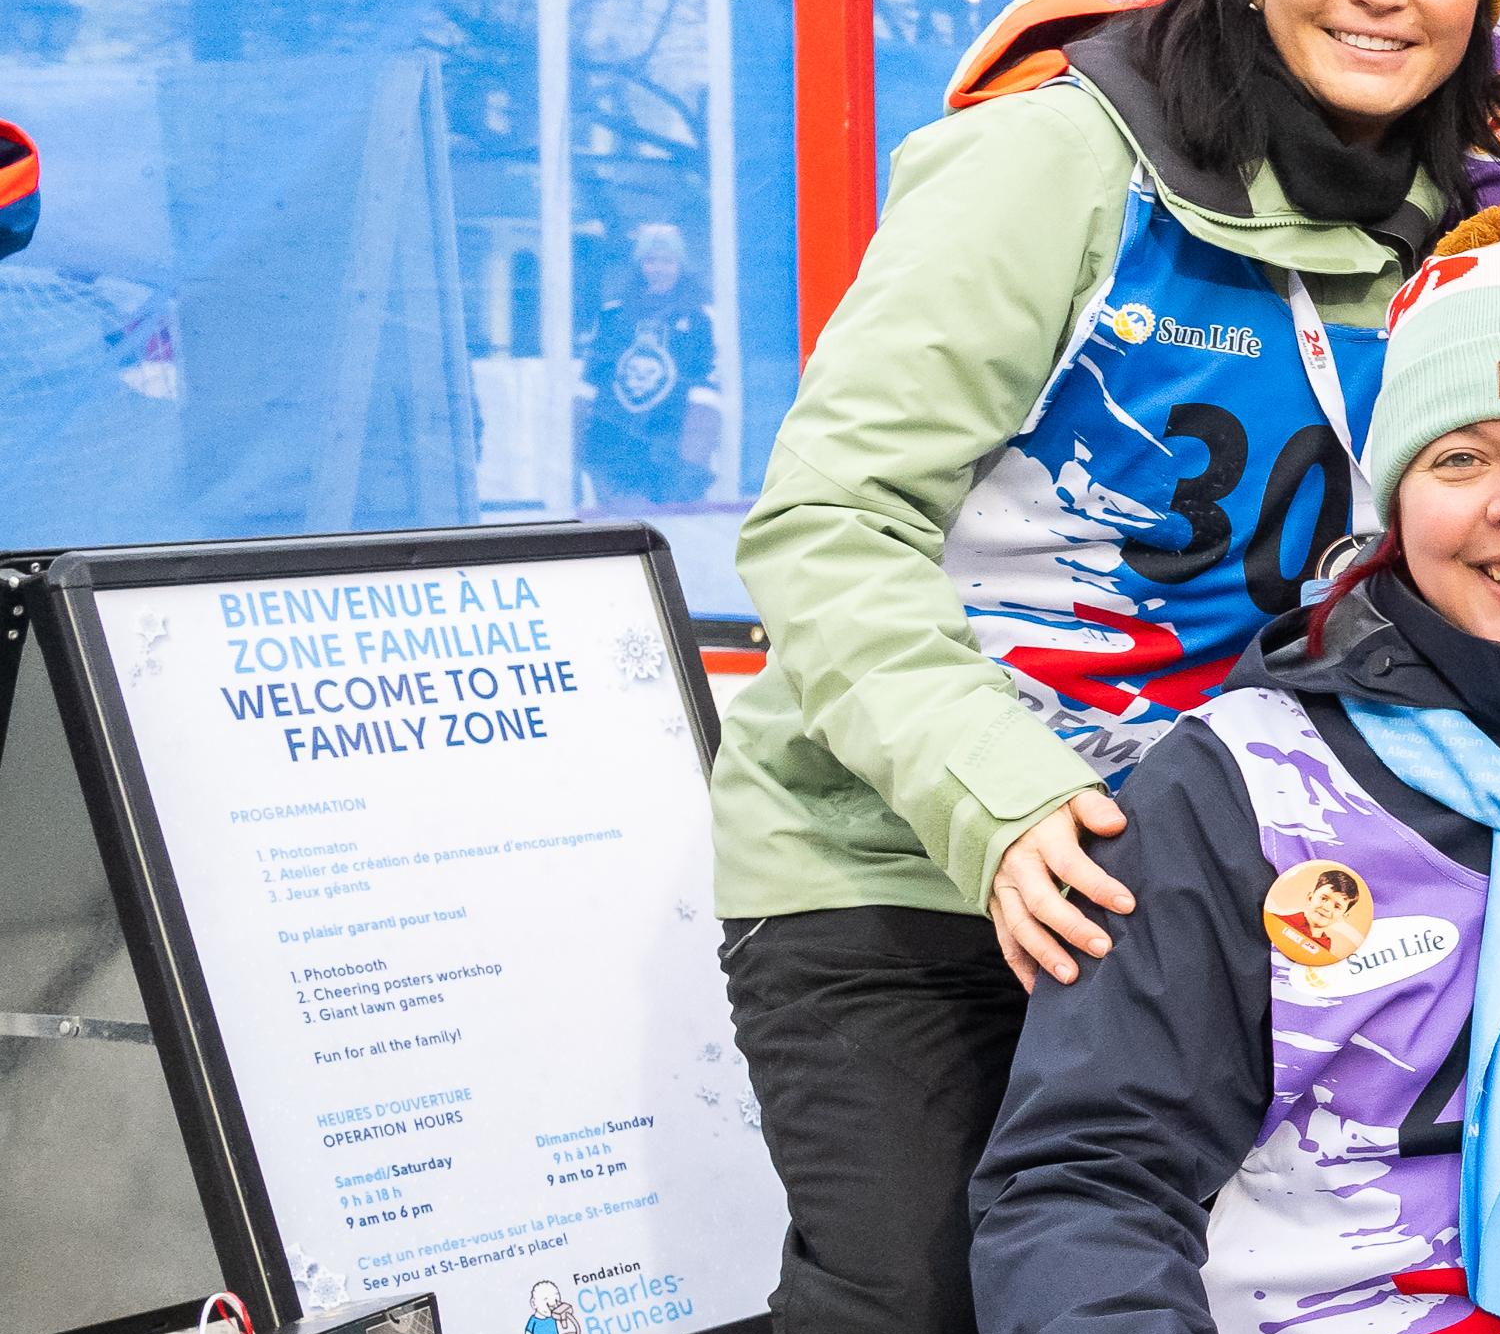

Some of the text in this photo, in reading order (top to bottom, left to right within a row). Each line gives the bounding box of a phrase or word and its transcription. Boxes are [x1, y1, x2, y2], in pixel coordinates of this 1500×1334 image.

[1157, 318, 1261, 356] Sun Life
[1120, 402, 1353, 615] 30
[219, 570, 540, 628] BIENVENUE À LA
[228, 619, 551, 674] ZONE FAMILIALE
[220, 660, 578, 720] WELCOME TO THE
[284, 706, 547, 762] FAMILY ZONE
[230, 797, 366, 823] PROGRAMMATION
[256, 840, 358, 862] 1. Photomaton
[263, 826, 623, 883] 2. Atelier de création de panneaux d'encouragements
[268, 879, 371, 903] 3. Jeux géants
[278, 906, 467, 944] Du plaisir garanti pour tous!
[290, 959, 388, 984] 1. Photobooth
[1347, 945, 1398, 975] Sun
[1400, 930, 1446, 957] Life
[297, 962, 503, 1004] 2. Cheering posters workshop
[303, 992, 444, 1024] 3. Giant lawn games
[314, 1028, 463, 1065] Fun for all the family!
[317, 1087, 472, 1129] HEURES D'OUVERTURE
[323, 1110, 464, 1149] OPERATION HOURS
[535, 1114, 655, 1149] Dimanche/Sunday
[335, 1155, 453, 1190] Samedi/Saturday
[547, 1160, 627, 1187] 9 am to 2 pm
[552, 1143, 612, 1166] 9 h à 14 h
[340, 1186, 402, 1209] 9 h à 18 h
[346, 1201, 433, 1230] 9 am to 6 pm
[357, 1192, 659, 1270] C'est un rendez-vous sur la Place St-Bernard!
[363, 1233, 568, 1291] See you at St-Bernard's place!
[573, 1260, 641, 1285] Fondation
[577, 1272, 685, 1314] Charles-
